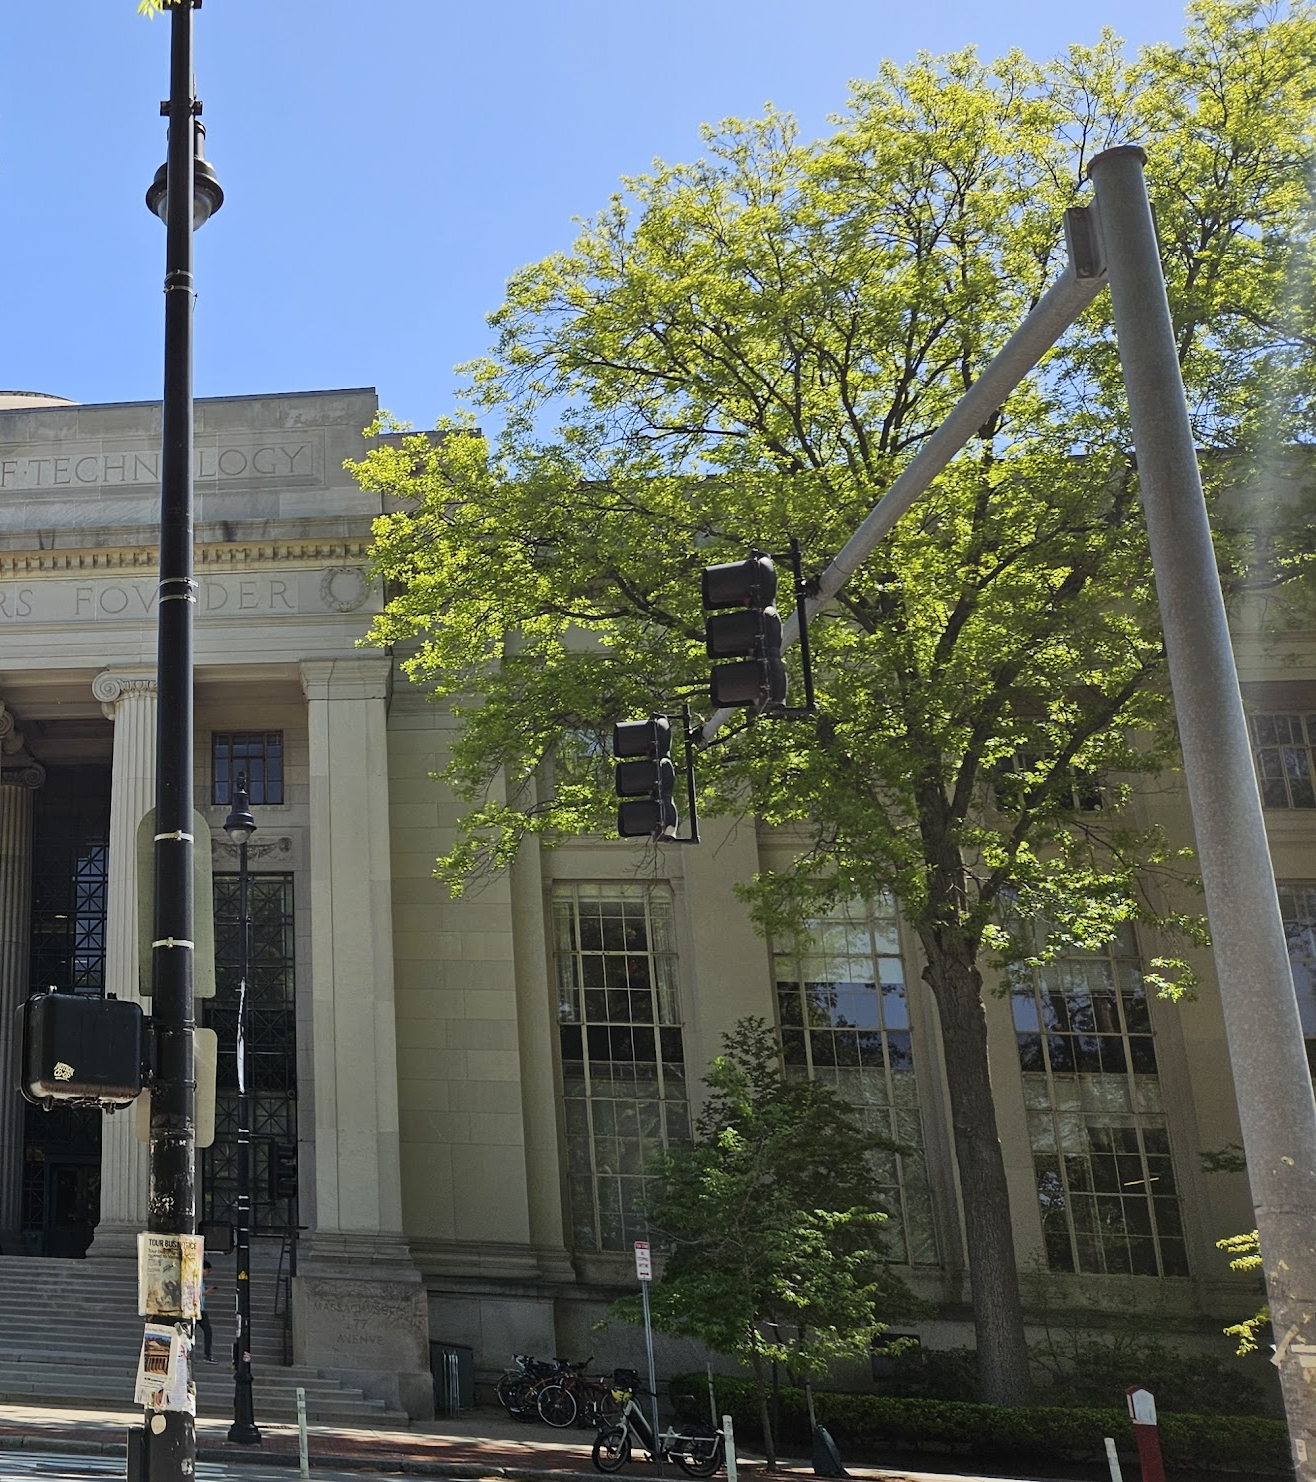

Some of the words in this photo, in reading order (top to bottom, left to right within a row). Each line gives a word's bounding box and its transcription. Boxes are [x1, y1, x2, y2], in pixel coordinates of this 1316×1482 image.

[27, 445, 305, 486] TECHNLOGY
[74, 580, 295, 615] FOVDER
[148, 1238, 164, 1247] TOUR
[164, 1239, 177, 1248] BUS
[353, 1318, 368, 1330] 77
[336, 1333, 385, 1346] AVENVE
